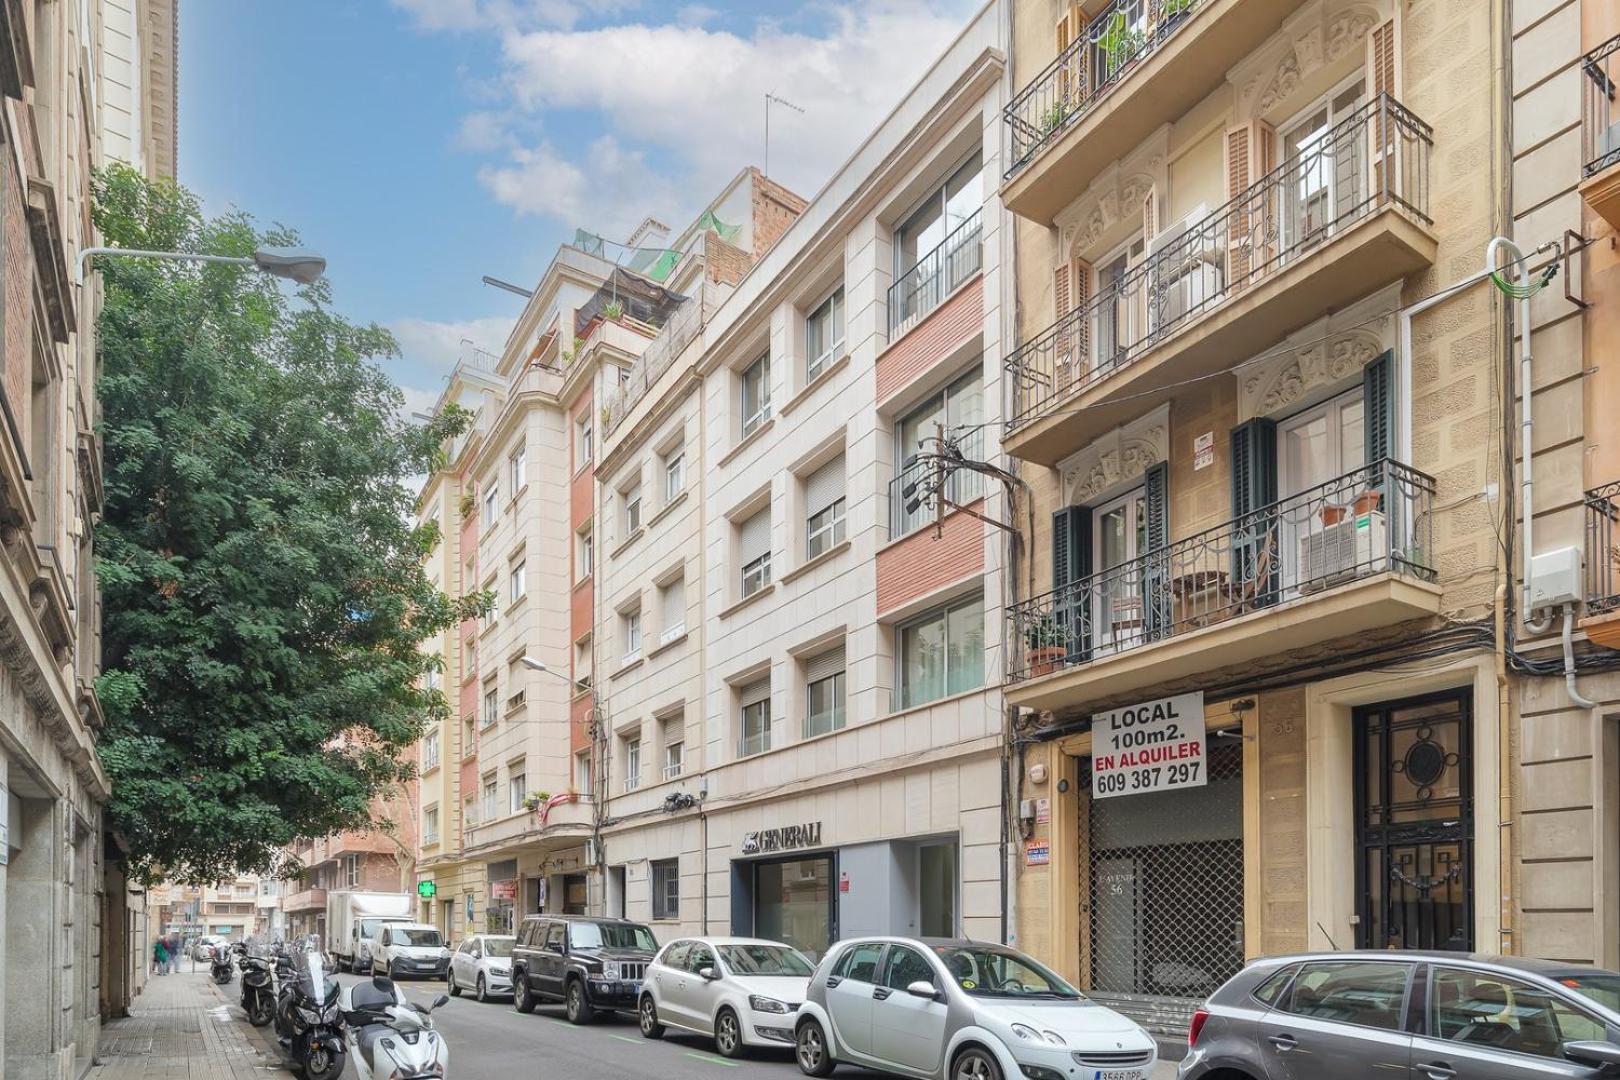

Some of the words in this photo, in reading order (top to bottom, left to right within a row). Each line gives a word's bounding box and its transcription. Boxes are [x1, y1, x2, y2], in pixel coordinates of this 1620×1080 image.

[1111, 701, 1179, 730] LOCAL
[1111, 724, 1185, 750] 100m2.
[1095, 755, 1115, 772] EN
[1119, 741, 1201, 768] ALQUILER
[1097, 772, 1126, 794] 609
[1131, 767, 1161, 789] 387
[1167, 761, 1200, 785] 297
[759, 821, 822, 853] GENERALI
